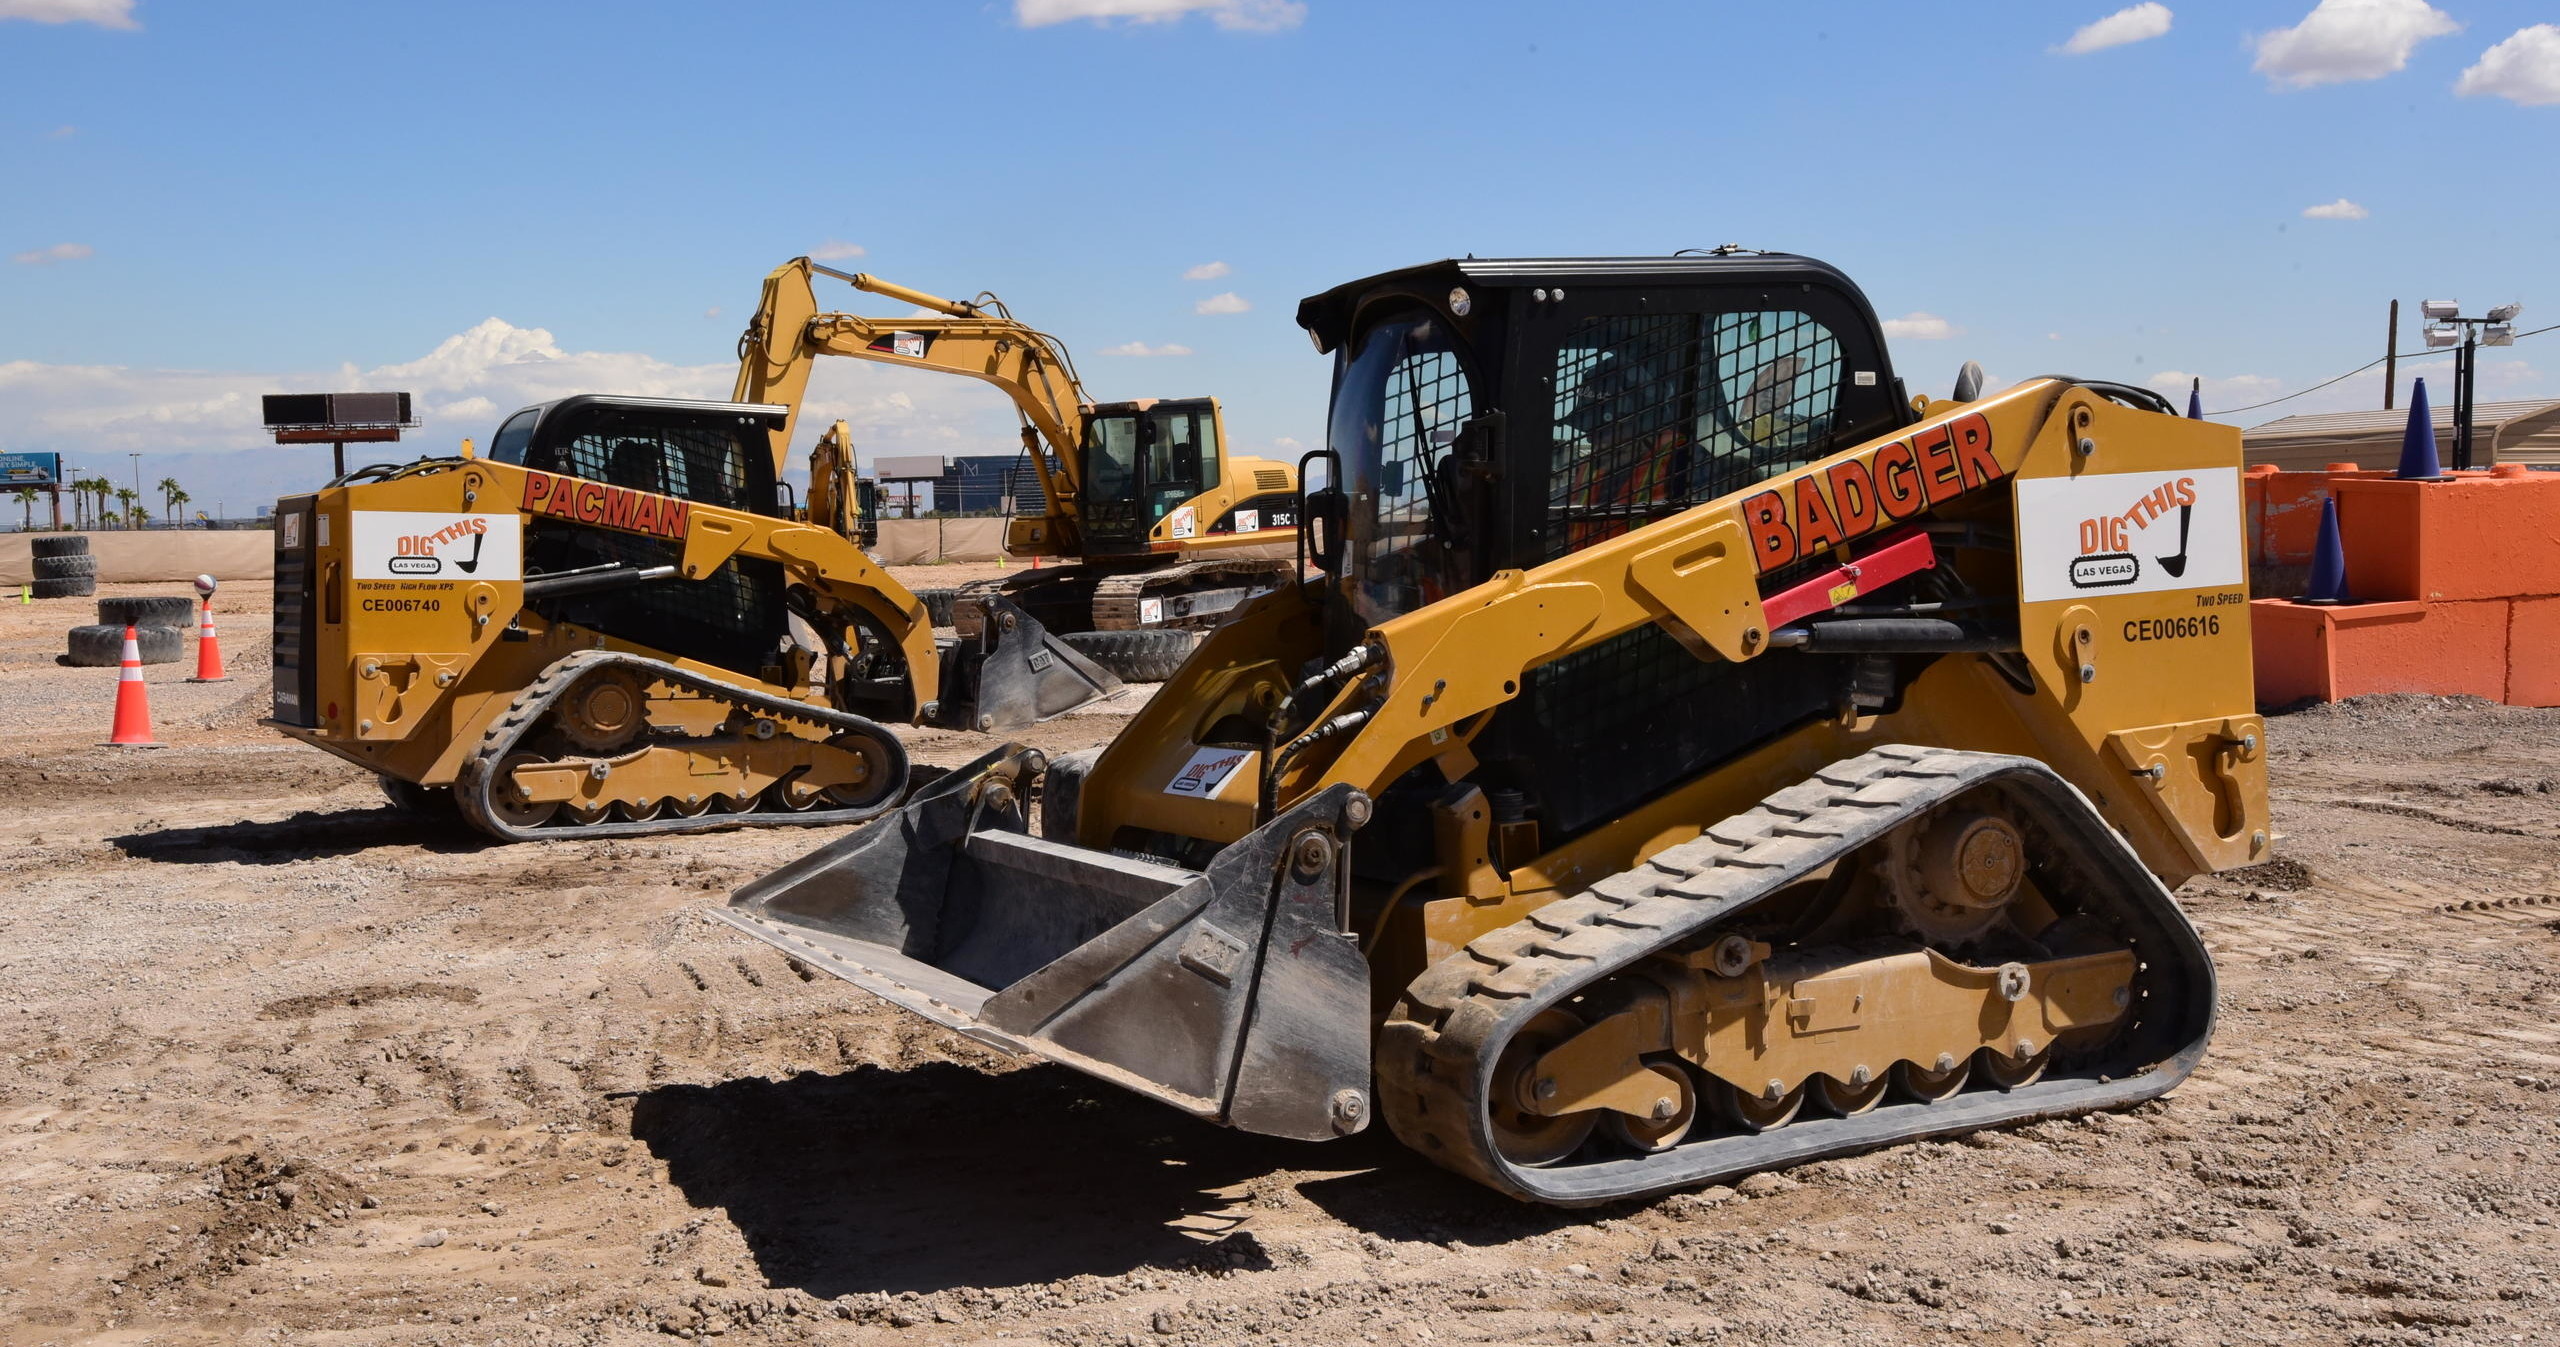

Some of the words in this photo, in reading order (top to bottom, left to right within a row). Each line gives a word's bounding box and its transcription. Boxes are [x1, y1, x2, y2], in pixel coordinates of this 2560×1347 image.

[1741, 412, 2004, 572] BADGER
[522, 471, 689, 540] PACMAN
[2080, 516, 2129, 555] DIG
[2123, 477, 2196, 530] THIS
[1272, 513, 1290, 525] 315C
[398, 536, 434, 556] DIG
[431, 518, 487, 545] THIS
[2077, 567, 2096, 577] LAS
[2099, 564, 2132, 575] VEGAS
[439, 583, 455, 591] XPS
[363, 599, 440, 612] CE006740
[2123, 614, 2220, 642] CE006616
[1186, 764, 1208, 778] DIG
[1209, 755, 1247, 771] THIS
